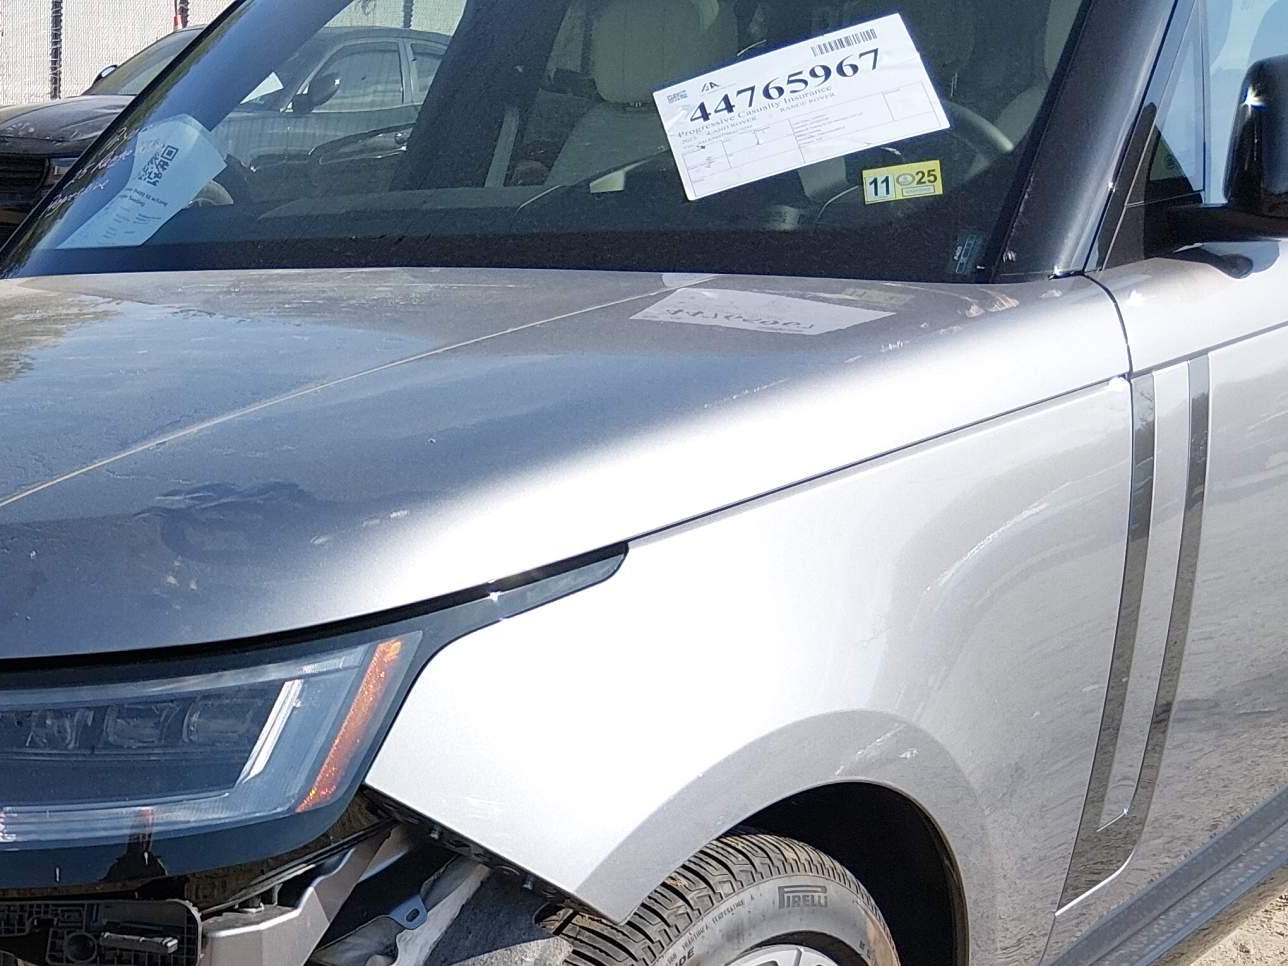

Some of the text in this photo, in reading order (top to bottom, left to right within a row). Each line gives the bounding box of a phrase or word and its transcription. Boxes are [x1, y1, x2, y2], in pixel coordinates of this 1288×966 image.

[689, 48, 879, 123] 44765967
[678, 113, 736, 139] Progressive
[737, 98, 781, 121] Casualty
[783, 86, 833, 106] Insurance
[869, 176, 890, 196] 11
[915, 169, 938, 185] 25
[778, 885, 828, 909] PIRELLI
